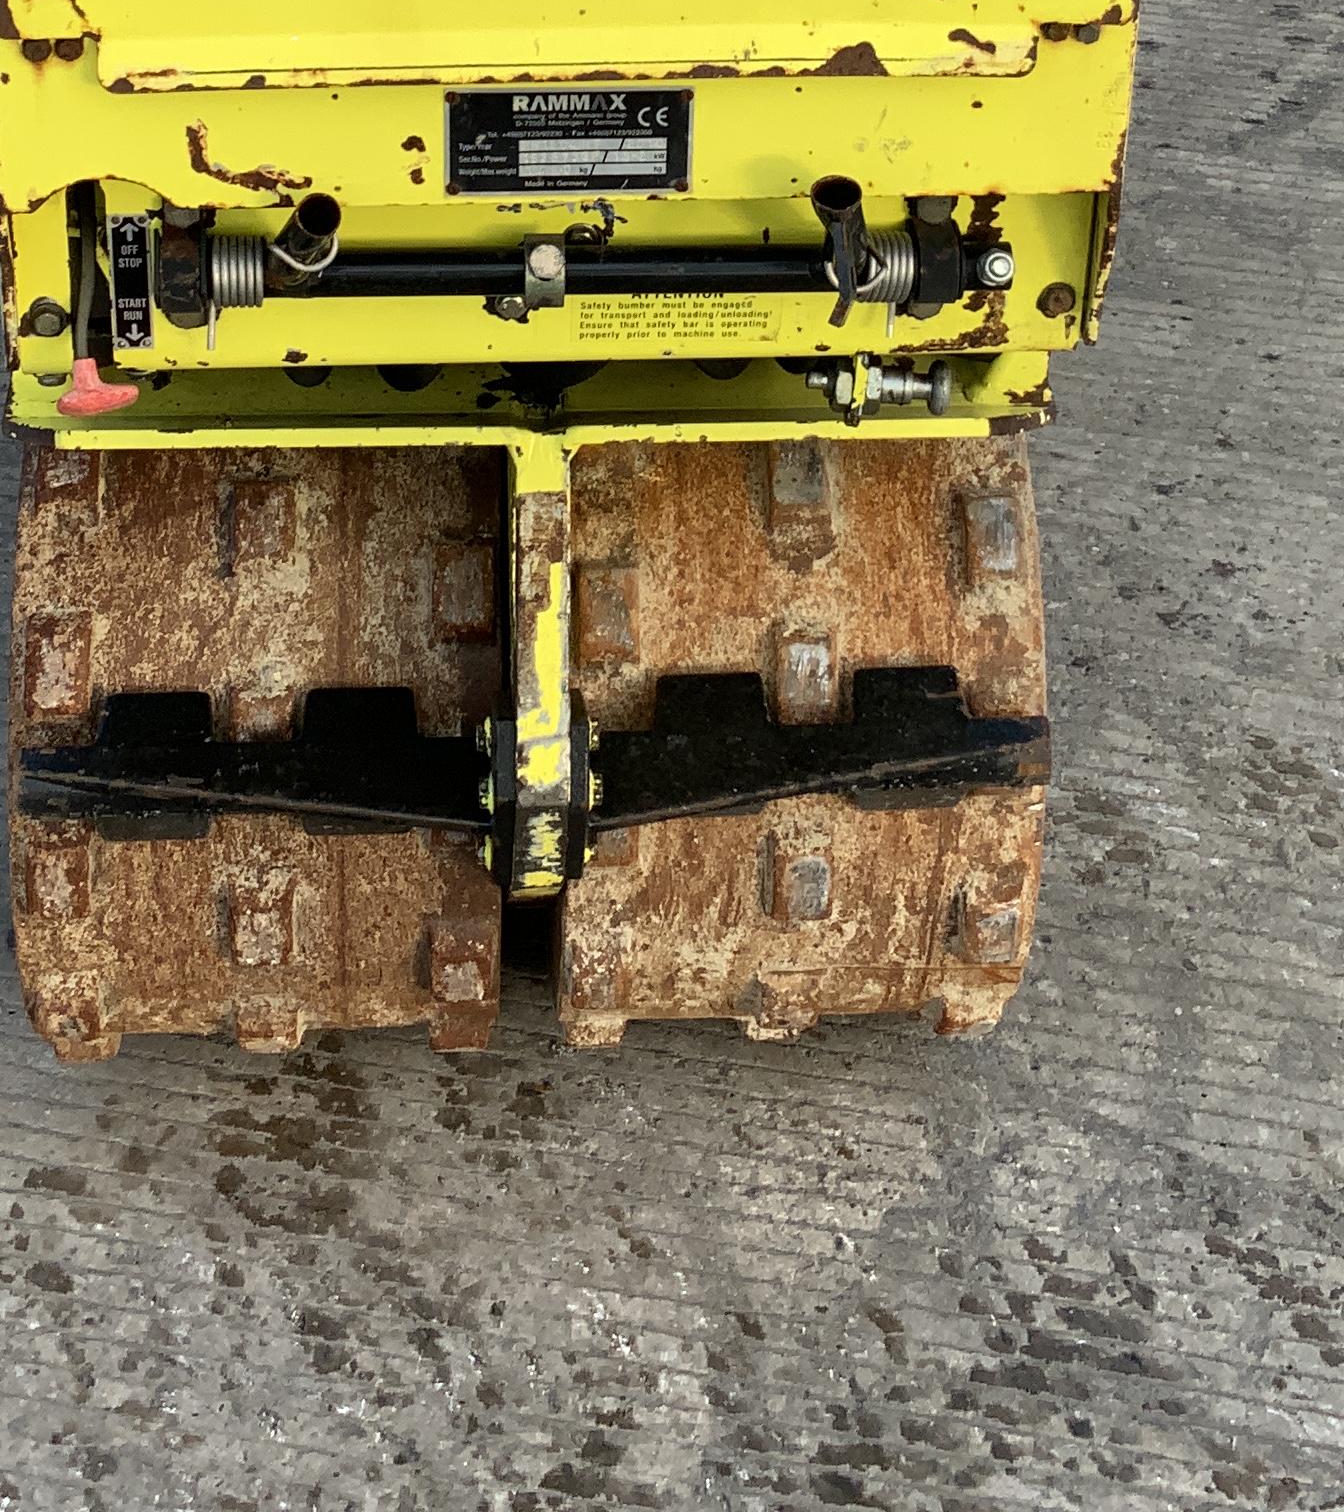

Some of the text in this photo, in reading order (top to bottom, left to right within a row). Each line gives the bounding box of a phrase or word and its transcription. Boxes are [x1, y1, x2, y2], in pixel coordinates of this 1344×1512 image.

[512, 94, 627, 112] RAMMAX
[637, 106, 669, 127] CE
[593, 119, 625, 127] Germany
[556, 179, 589, 187] Germany
[120, 245, 139, 256] OFF
[118, 257, 143, 268] STOP
[117, 298, 147, 308] START
[580, 302, 611, 311] Safety
[618, 301, 655, 309] bumber
[123, 310, 143, 321] RUN
[600, 311, 646, 320] transport
[653, 311, 671, 319] and
[580, 321, 613, 329] Ensure
[646, 320, 676, 330] safety
[721, 320, 768, 329] operating
[579, 331, 620, 340] properly
[627, 331, 650, 340] prior
[674, 330, 714, 338] machine
